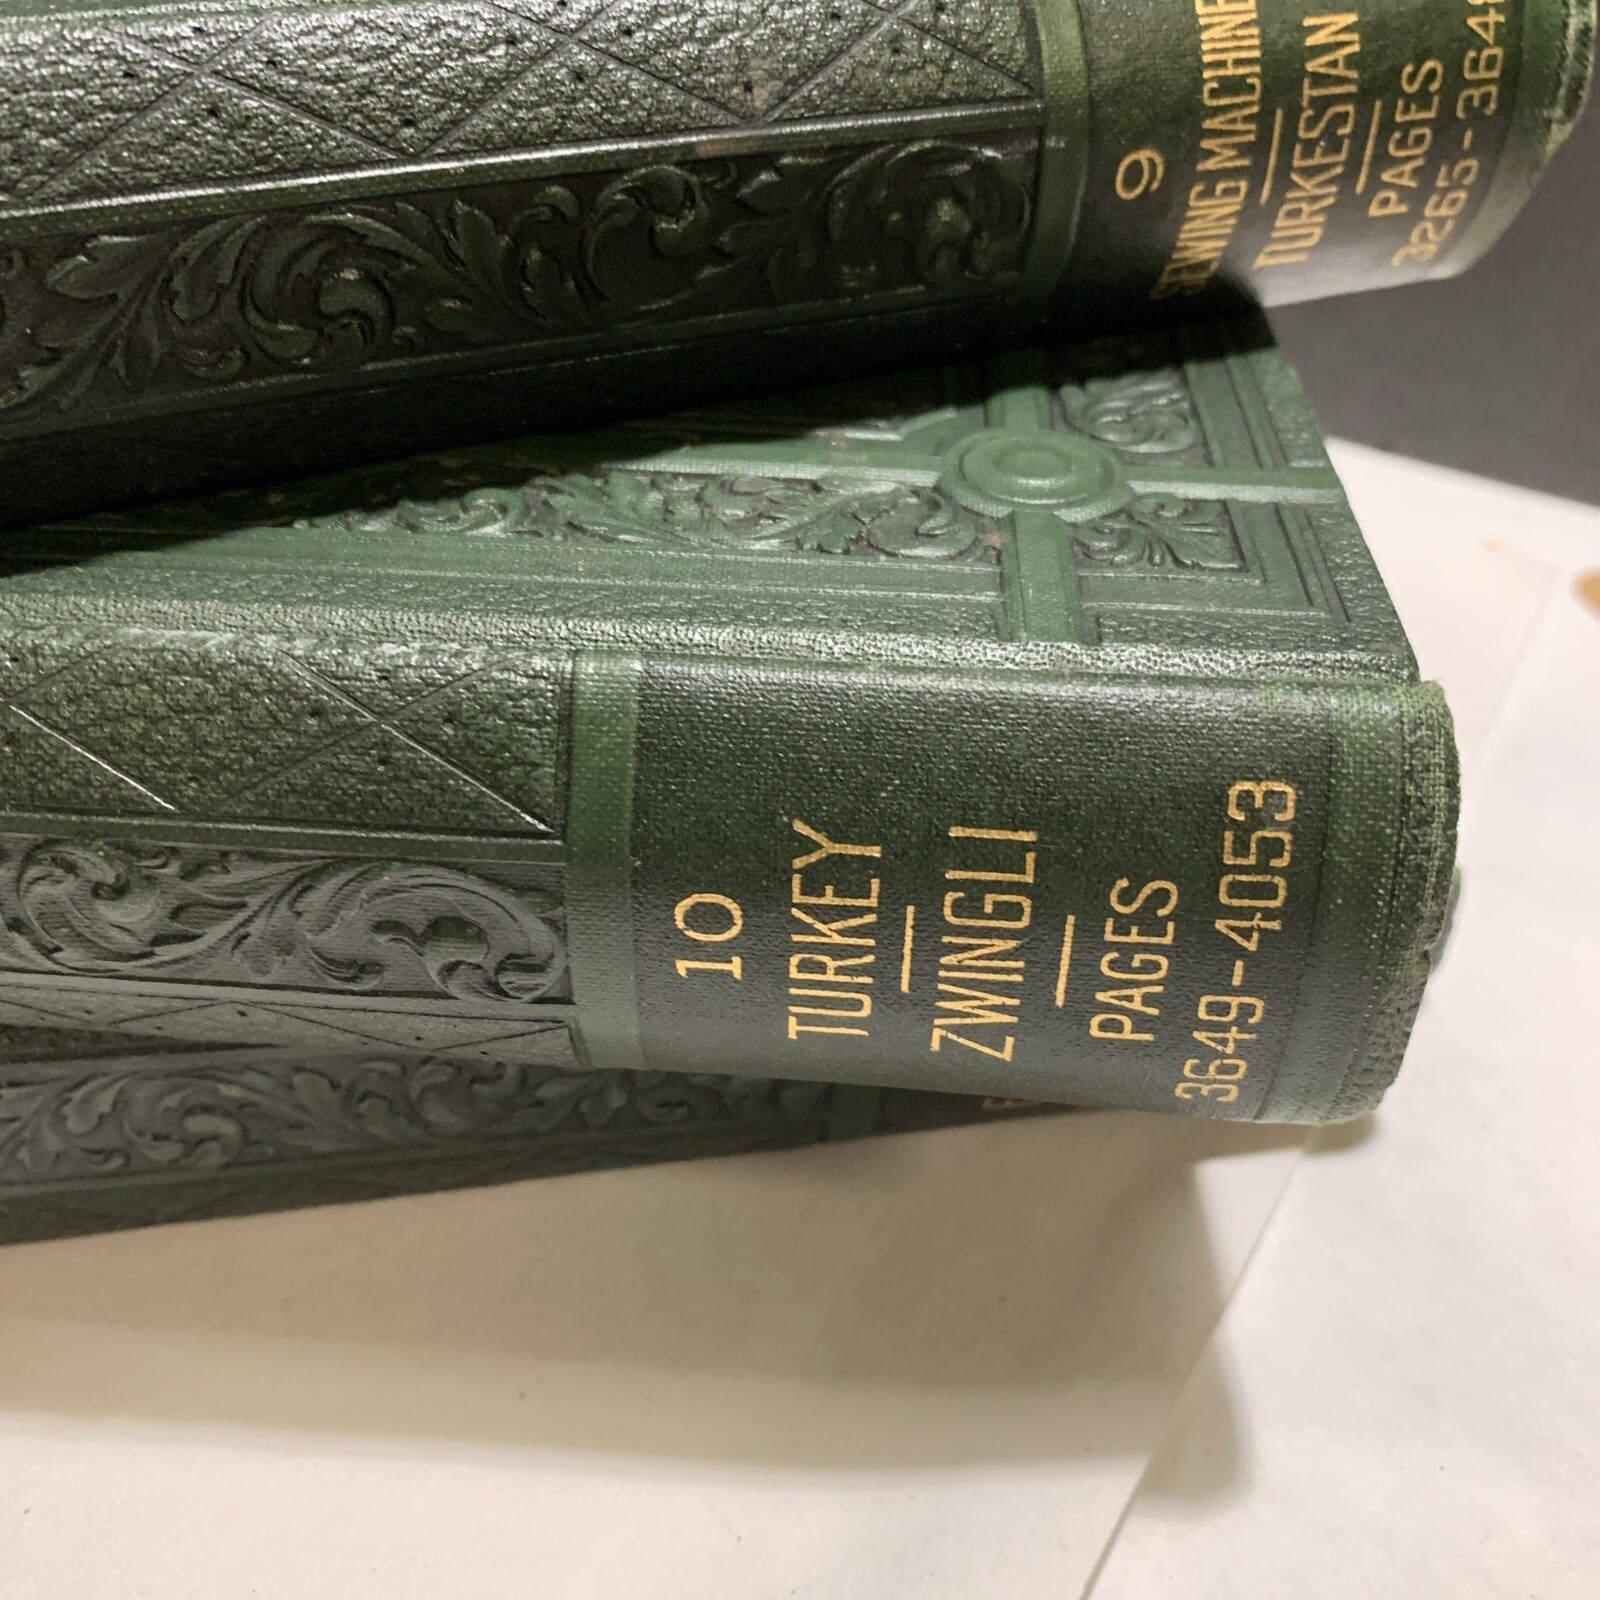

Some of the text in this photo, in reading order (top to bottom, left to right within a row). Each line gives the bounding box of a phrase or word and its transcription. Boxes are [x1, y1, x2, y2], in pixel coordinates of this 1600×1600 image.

[1114, 147, 1165, 201] 9
[1252, 11, 1361, 271] TURKESTAN
[1368, 58, 1445, 219] PAGES
[1391, 0, 1506, 267] 3265-364
[673, 892, 743, 981] 10
[788, 818, 882, 1039] TURKEY
[930, 825, 1038, 1062] ZWINGLI
[1089, 876, 1179, 1042] PAGES
[1173, 779, 1297, 1103] 3649-4053
